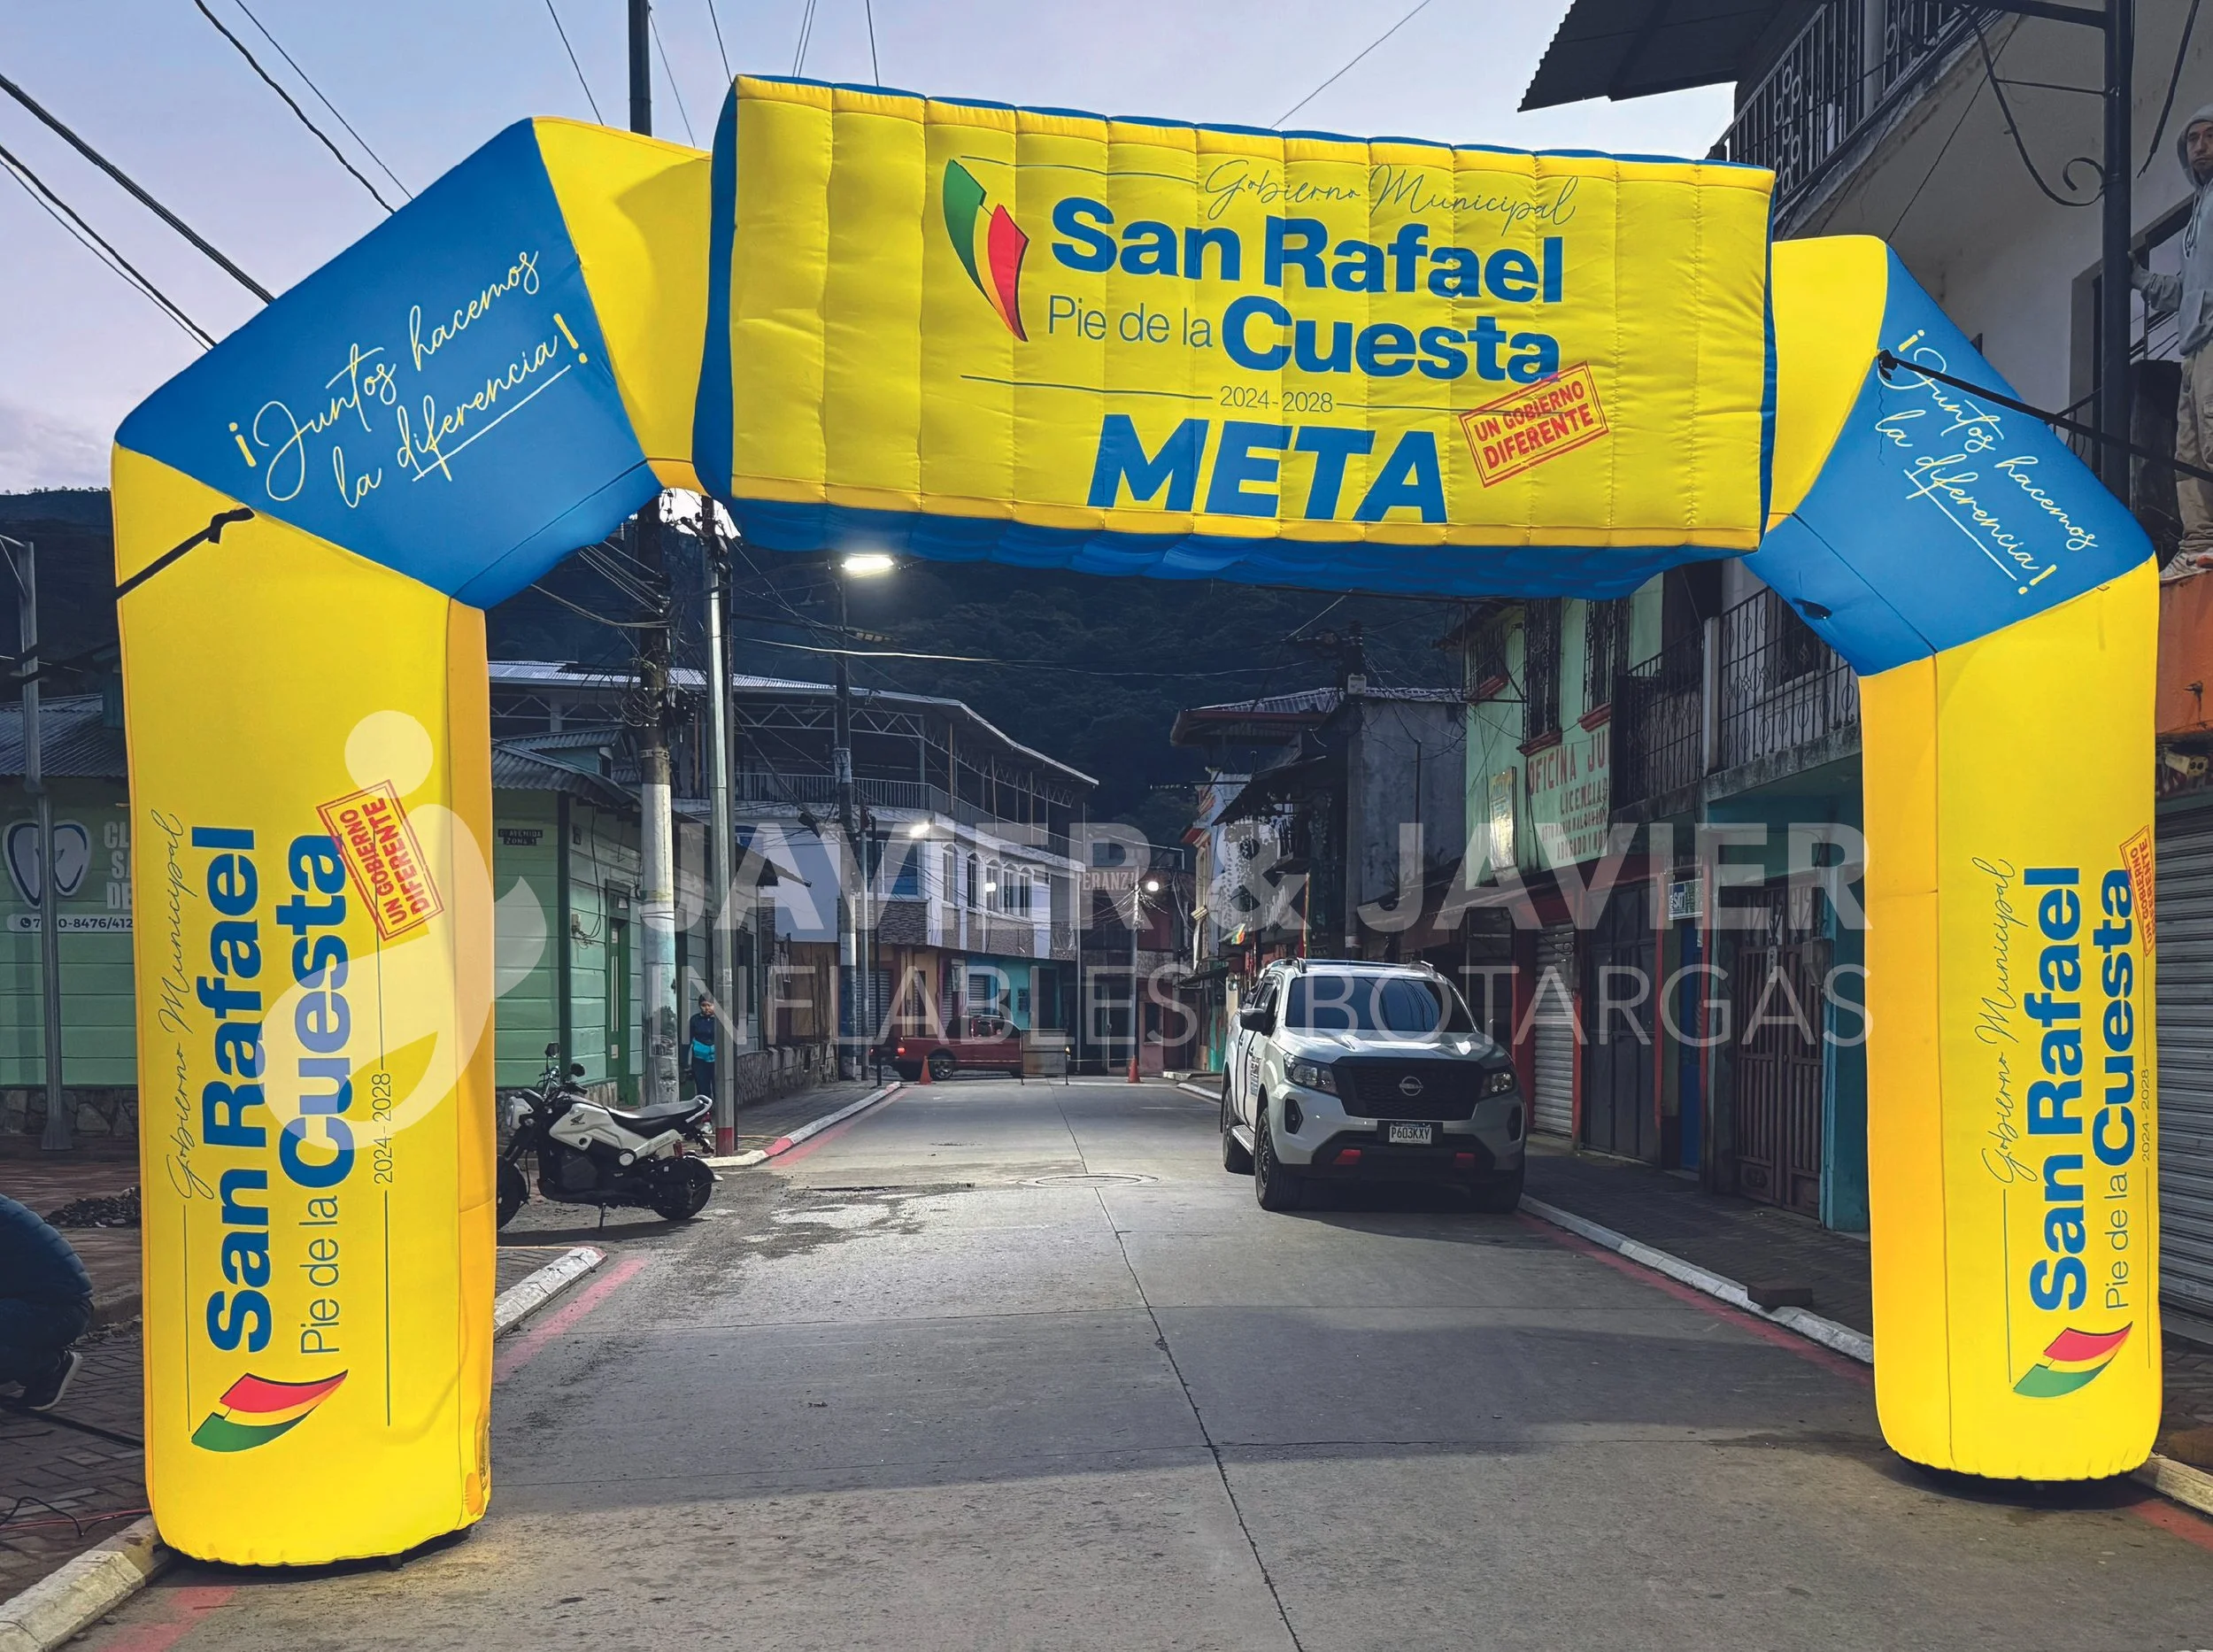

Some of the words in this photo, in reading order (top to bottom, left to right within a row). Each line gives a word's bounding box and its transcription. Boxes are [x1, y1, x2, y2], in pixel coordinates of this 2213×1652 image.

[1206, 159, 1360, 220] Gobierno
[1369, 164, 1578, 236] Municipal
[1052, 197, 1241, 282] San
[1264, 215, 1562, 303] Rafael
[409, 251, 539, 371] hacemos
[1049, 295, 1106, 341] Pie
[1119, 303, 1170, 344] de
[1184, 307, 1214, 348] la
[1222, 296, 1561, 383] Cuesta
[334, 447, 382, 508] la
[397, 313, 589, 482] diferencia!
[1220, 386, 1333, 414] 2024-2028
[1474, 417, 1502, 442] UN
[1503, 381, 1585, 430] GOBIERNO
[1483, 403, 1594, 469] DIFERENTE
[1086, 413, 1449, 523] META
[1876, 410, 1926, 447] la
[1906, 454, 2056, 595] diferencia!
[1994, 456, 2099, 551] hacemos
[1529, 743, 1577, 796] OFICINA
[340, 809, 395, 896] GOBIERNO
[362, 798, 431, 915] DIFERENTE
[2131, 847, 2149, 920] GOBIERNO
[150, 808, 198, 1034] Municipal
[383, 898, 407, 925] UN
[1972, 856, 2028, 1044] Municipal
[191, 826, 267, 1148] Rafael
[275, 834, 355, 1188] Cuesta
[2024, 868, 2084, 1135] Rafael
[2093, 869, 2134, 1167] Cuesta
[166, 1041, 214, 1200] Gobierno
[372, 1073, 393, 1184] 2024-2028
[1392, 1127, 1430, 1140] P603KXY
[1982, 1052, 2037, 1183] Gobierno
[2141, 1069, 2150, 1161] 2024-2028
[299, 1195, 338, 1232] la
[2030, 1154, 2087, 1310] San
[2104, 1172, 2127, 1199] la
[2104, 1209, 2128, 1250] de
[206, 1167, 272, 1353] San
[299, 1239, 339, 1287] de
[2106, 1261, 2129, 1309] Pie
[300, 1299, 340, 1354] Pie
